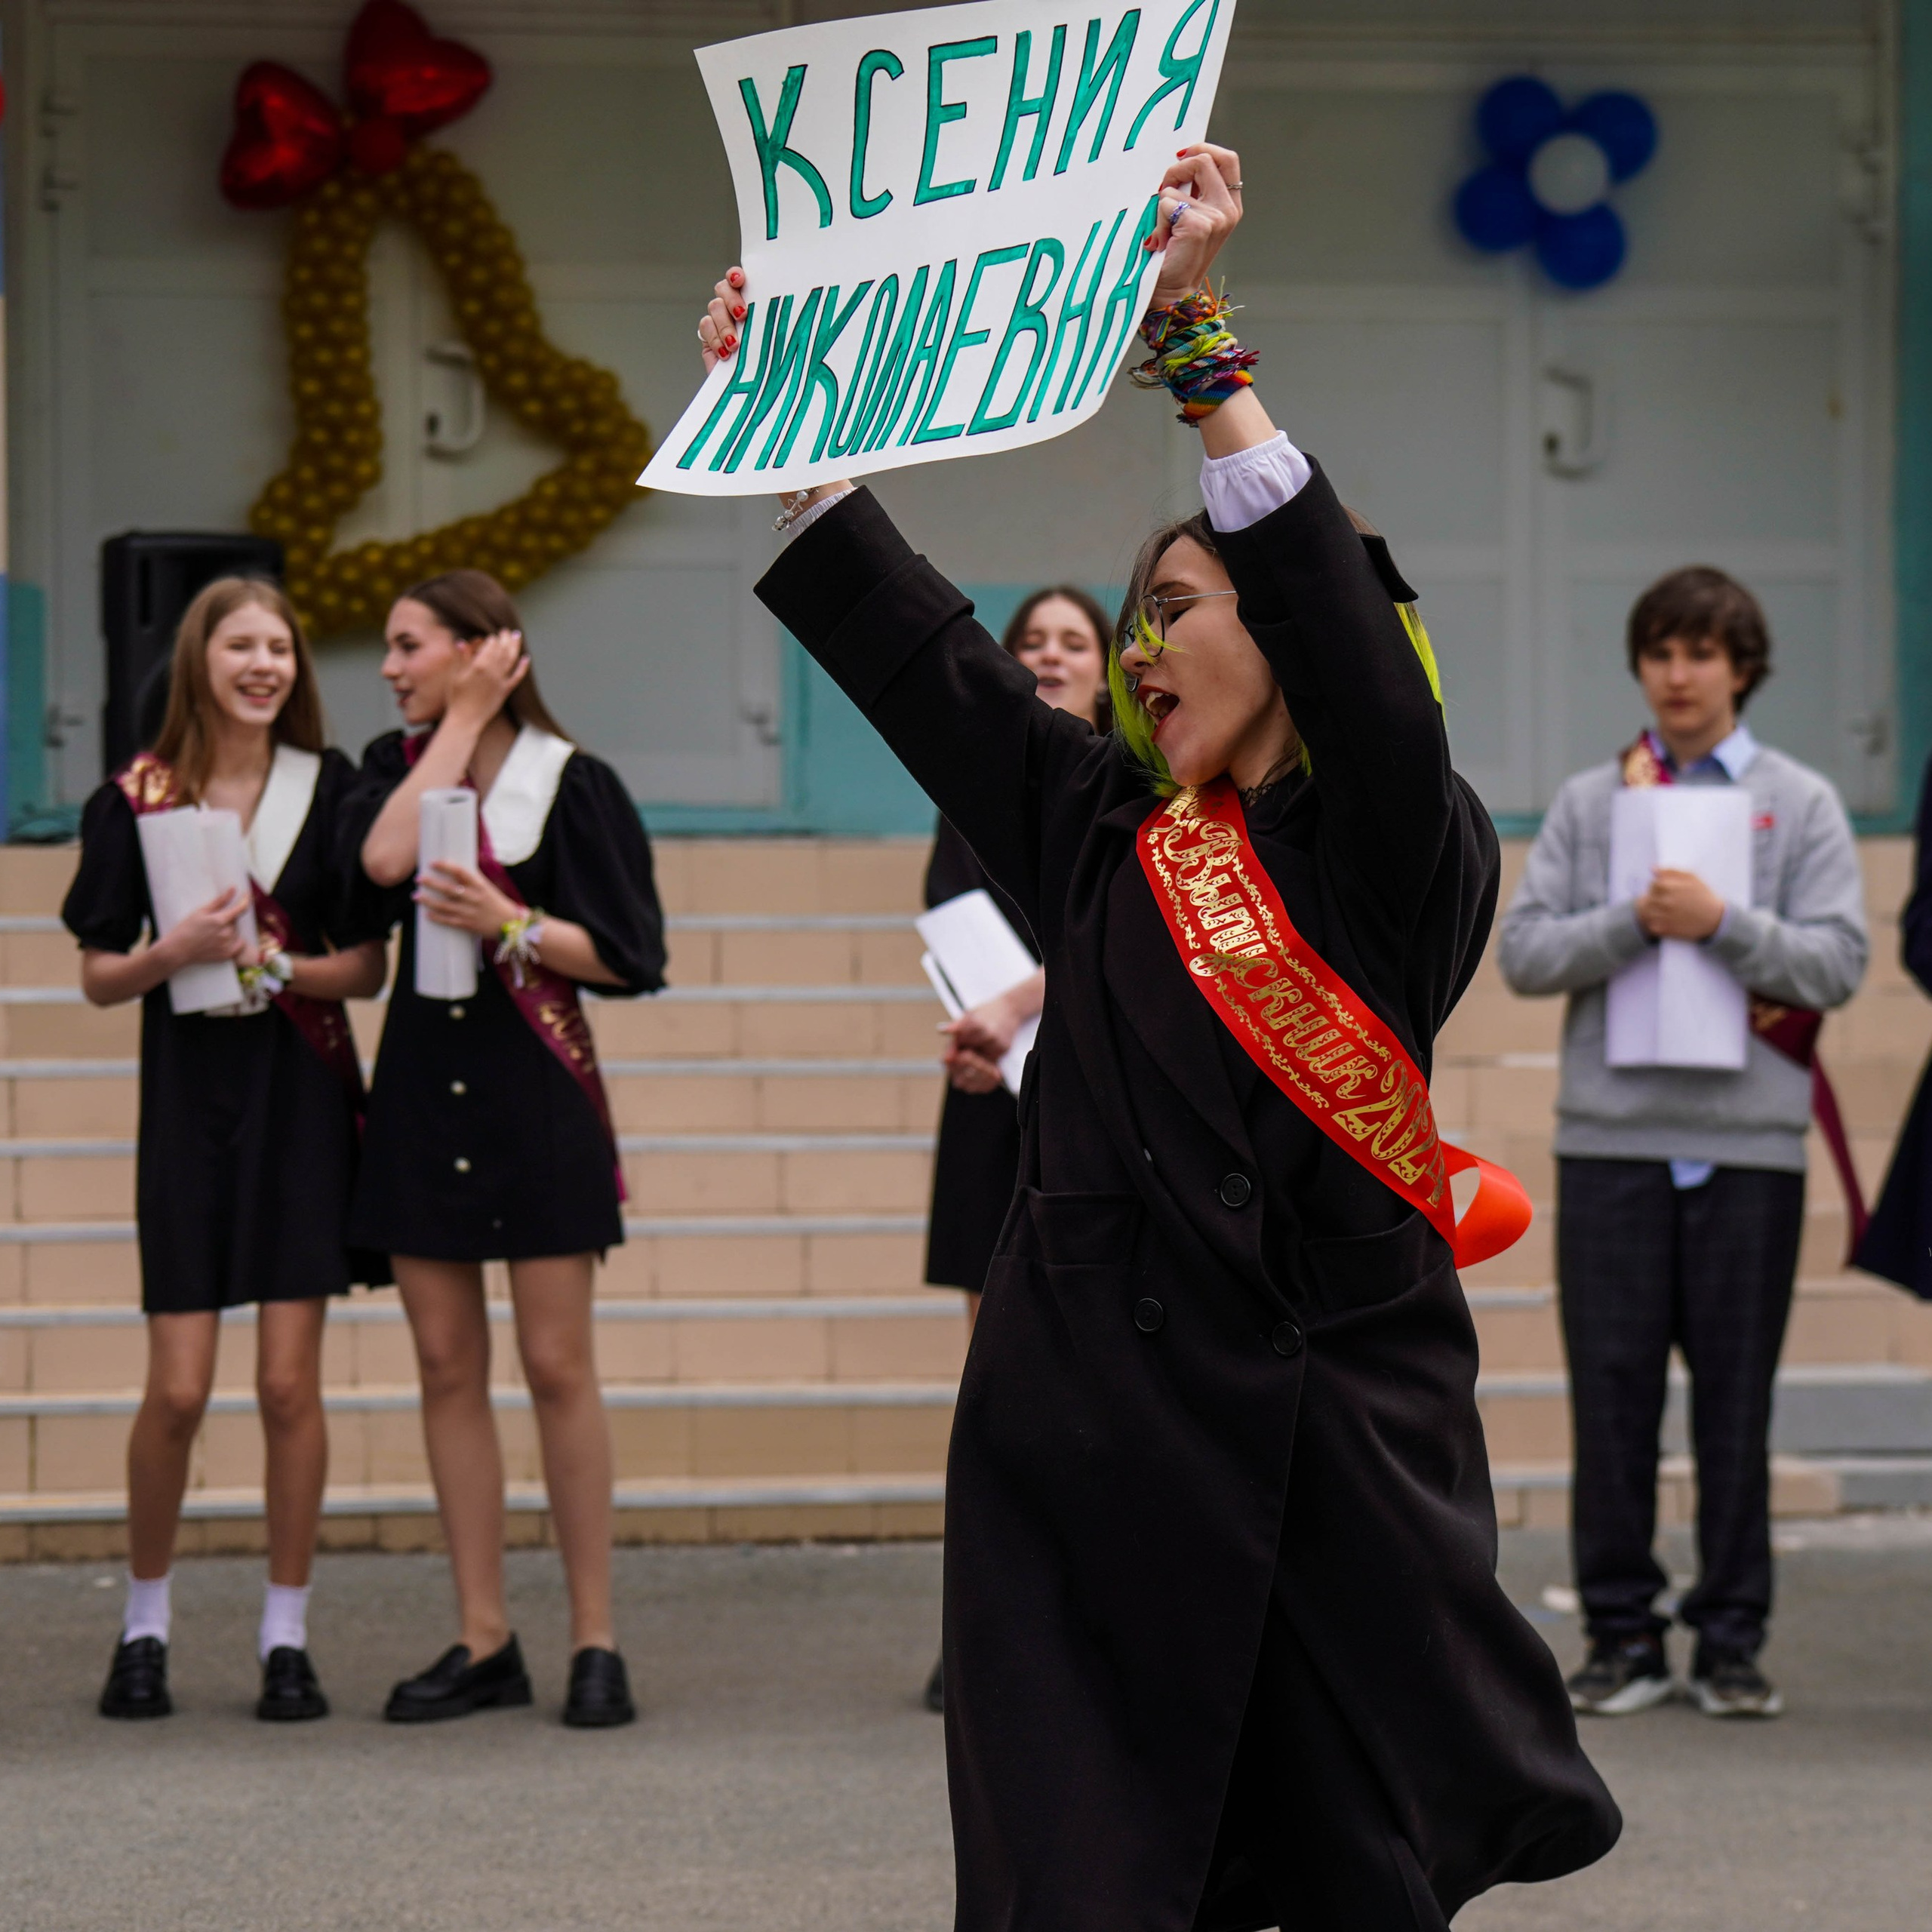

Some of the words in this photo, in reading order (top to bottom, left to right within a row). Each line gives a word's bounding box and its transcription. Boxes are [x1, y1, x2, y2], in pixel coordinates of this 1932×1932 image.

[738, 0, 1220, 240] КСЕНИЯ
[676, 194, 1160, 473] НИКОЛАЕВНА
[1163, 820, 1378, 1100] Выпускник
[1331, 1059, 1445, 1208] 2024
